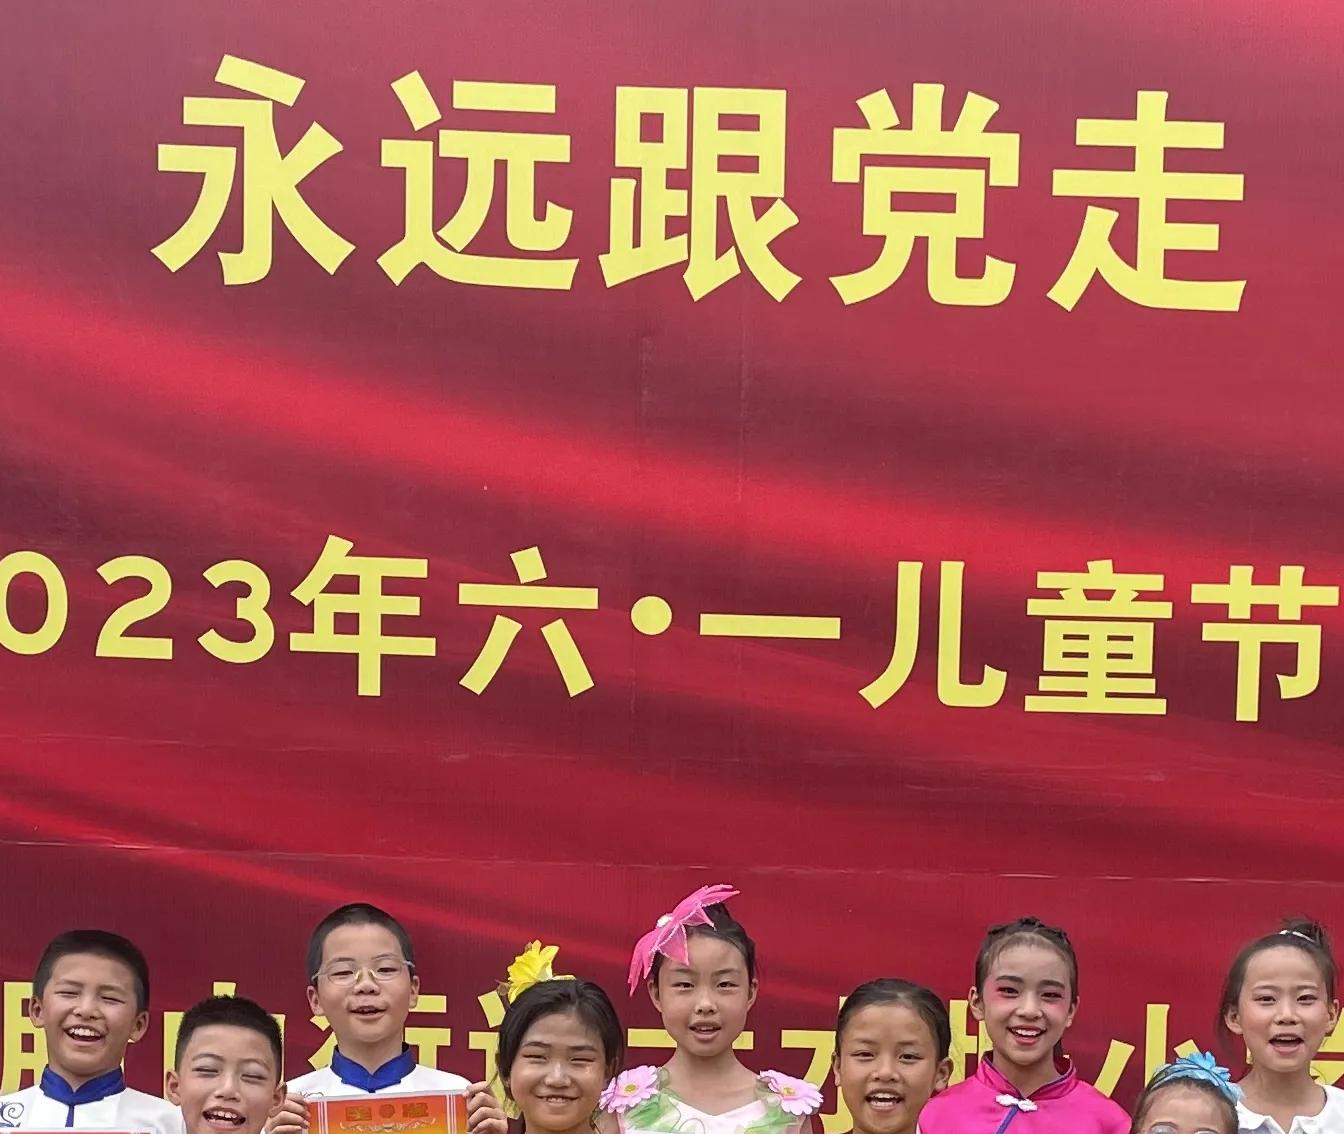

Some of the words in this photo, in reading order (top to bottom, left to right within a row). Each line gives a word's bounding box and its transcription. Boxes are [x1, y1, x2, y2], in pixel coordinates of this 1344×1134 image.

[153, 56, 1245, 311] 永远跟党走
